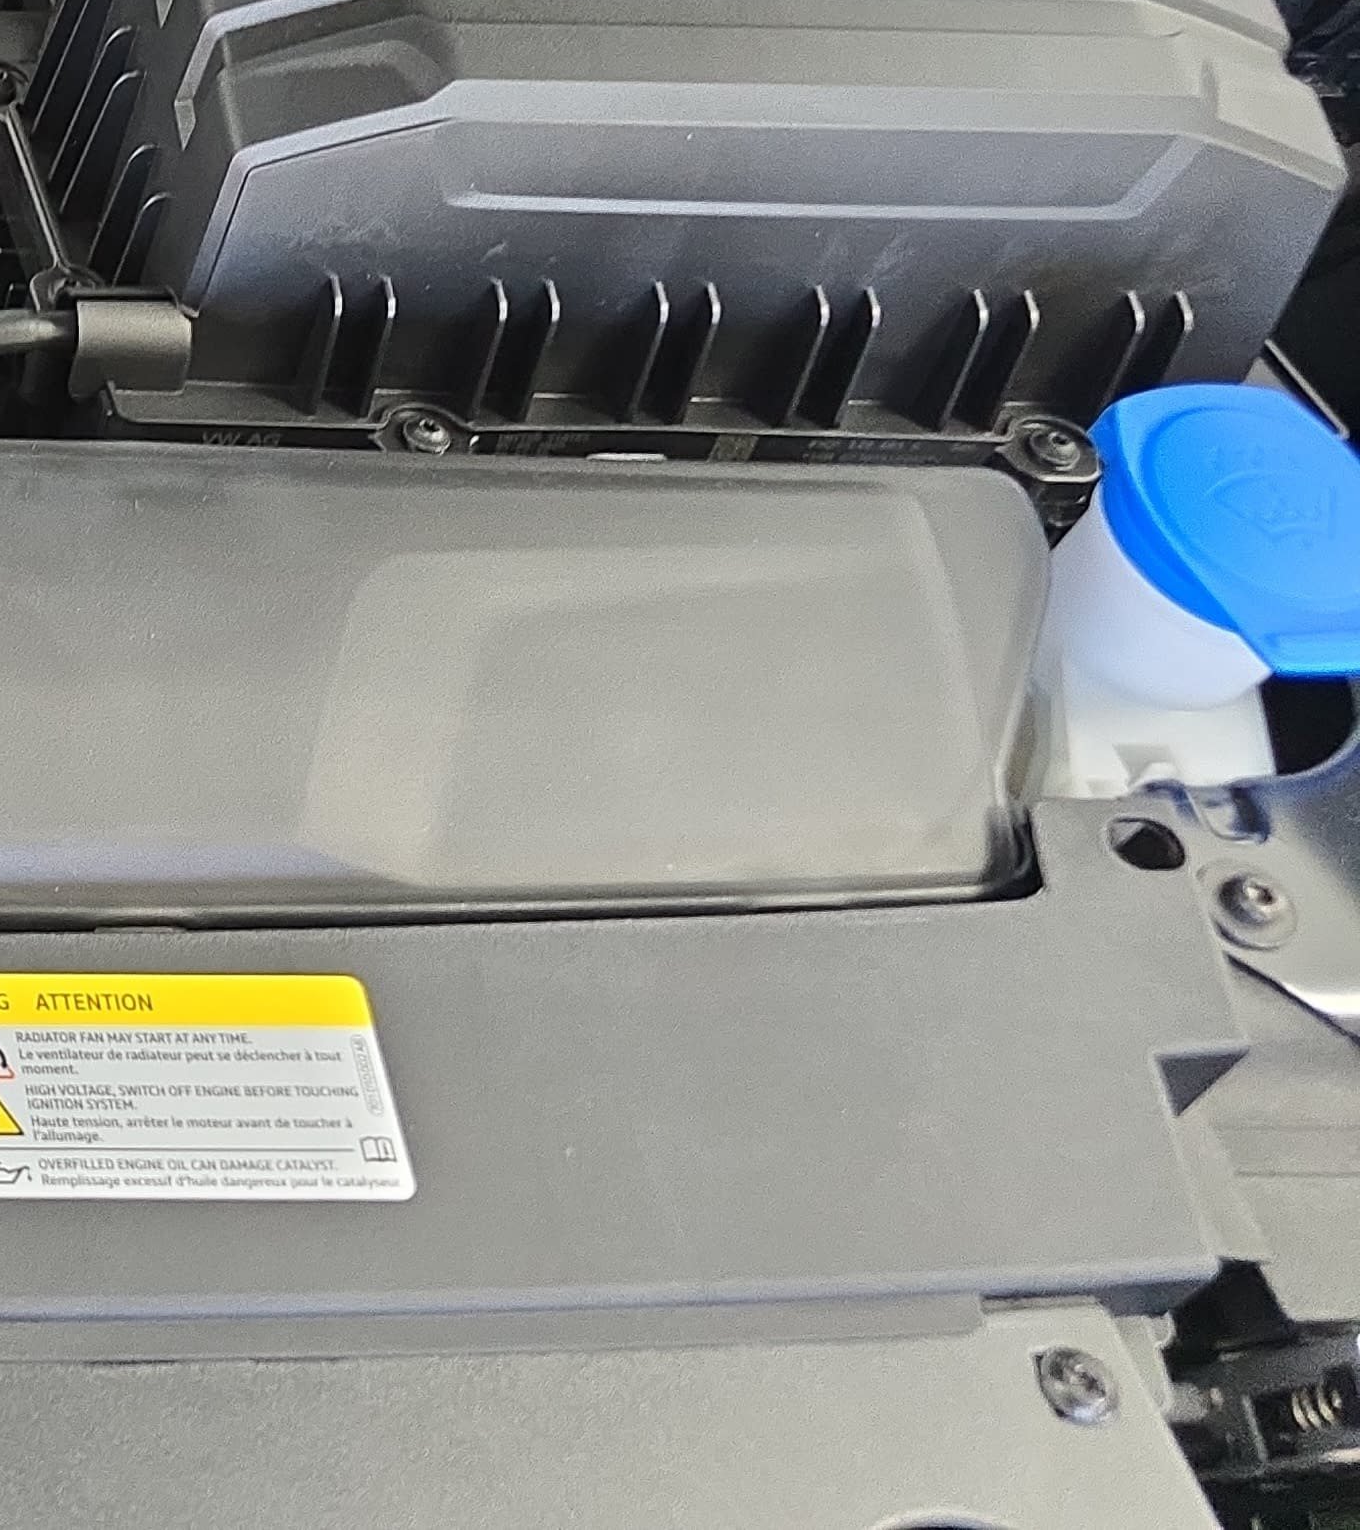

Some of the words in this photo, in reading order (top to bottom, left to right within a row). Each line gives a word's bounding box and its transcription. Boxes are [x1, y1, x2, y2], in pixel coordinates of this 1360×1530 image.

[36, 993, 154, 1011] ATTENTION
[15, 1031, 77, 1044] RADIATOR
[80, 1031, 104, 1043] FAN
[107, 1031, 131, 1043] MAY
[135, 1032, 173, 1044] START
[175, 1033, 191, 1044] AT
[192, 1033, 217, 1044] ANY
[219, 1033, 253, 1044] TIME.
[18, 1049, 33, 1060] Le
[37, 1049, 104, 1061] ventilateur
[107, 1049, 123, 1061] de
[126, 1049, 181, 1061] radiateur
[186, 1051, 214, 1063] peut
[217, 1052, 230, 1062] se
[234, 1050, 301, 1062] déclencher
[305, 1050, 312, 1062] à
[315, 1050, 341, 1062] tout
[21, 1064, 79, 1076] moment.
[25, 1084, 56, 1096] HIGH
[58, 1084, 117, 1097] VOLTAGE,
[119, 1084, 165, 1096] SWITCH
[168, 1084, 191, 1096] OFF
[195, 1085, 242, 1097] ENGINE
[244, 1085, 292, 1097] BEFORE
[294, 1085, 359, 1098] TOUCHING
[28, 1098, 83, 1110] IGNITION
[86, 1098, 138, 1110] SYSTEM.
[31, 1115, 69, 1128] Haute
[72, 1116, 124, 1129] tension,
[126, 1116, 169, 1128] arrêter
[172, 1116, 183, 1128] le
[186, 1118, 232, 1128] moteur
[237, 1118, 271, 1129] avant
[274, 1117, 290, 1129] de
[293, 1117, 338, 1129] toucher
[345, 1117, 353, 1129] à
[33, 1129, 103, 1144] l'allumage.
[38, 1157, 114, 1170] OVERFILLED
[118, 1158, 164, 1170] ENGINE
[167, 1159, 188, 1170] OIL
[191, 1159, 217, 1171] CAN
[220, 1159, 272, 1171] DAMAGE
[275, 1159, 338, 1171] CATALYST.
[41, 1173, 120, 1189] Remplissage
[124, 1175, 172, 1186] excessif
[176, 1175, 218, 1187] d'huile
[222, 1177, 287, 1190] dangereux
[291, 1178, 318, 1189] pour
[321, 1176, 333, 1187] le
